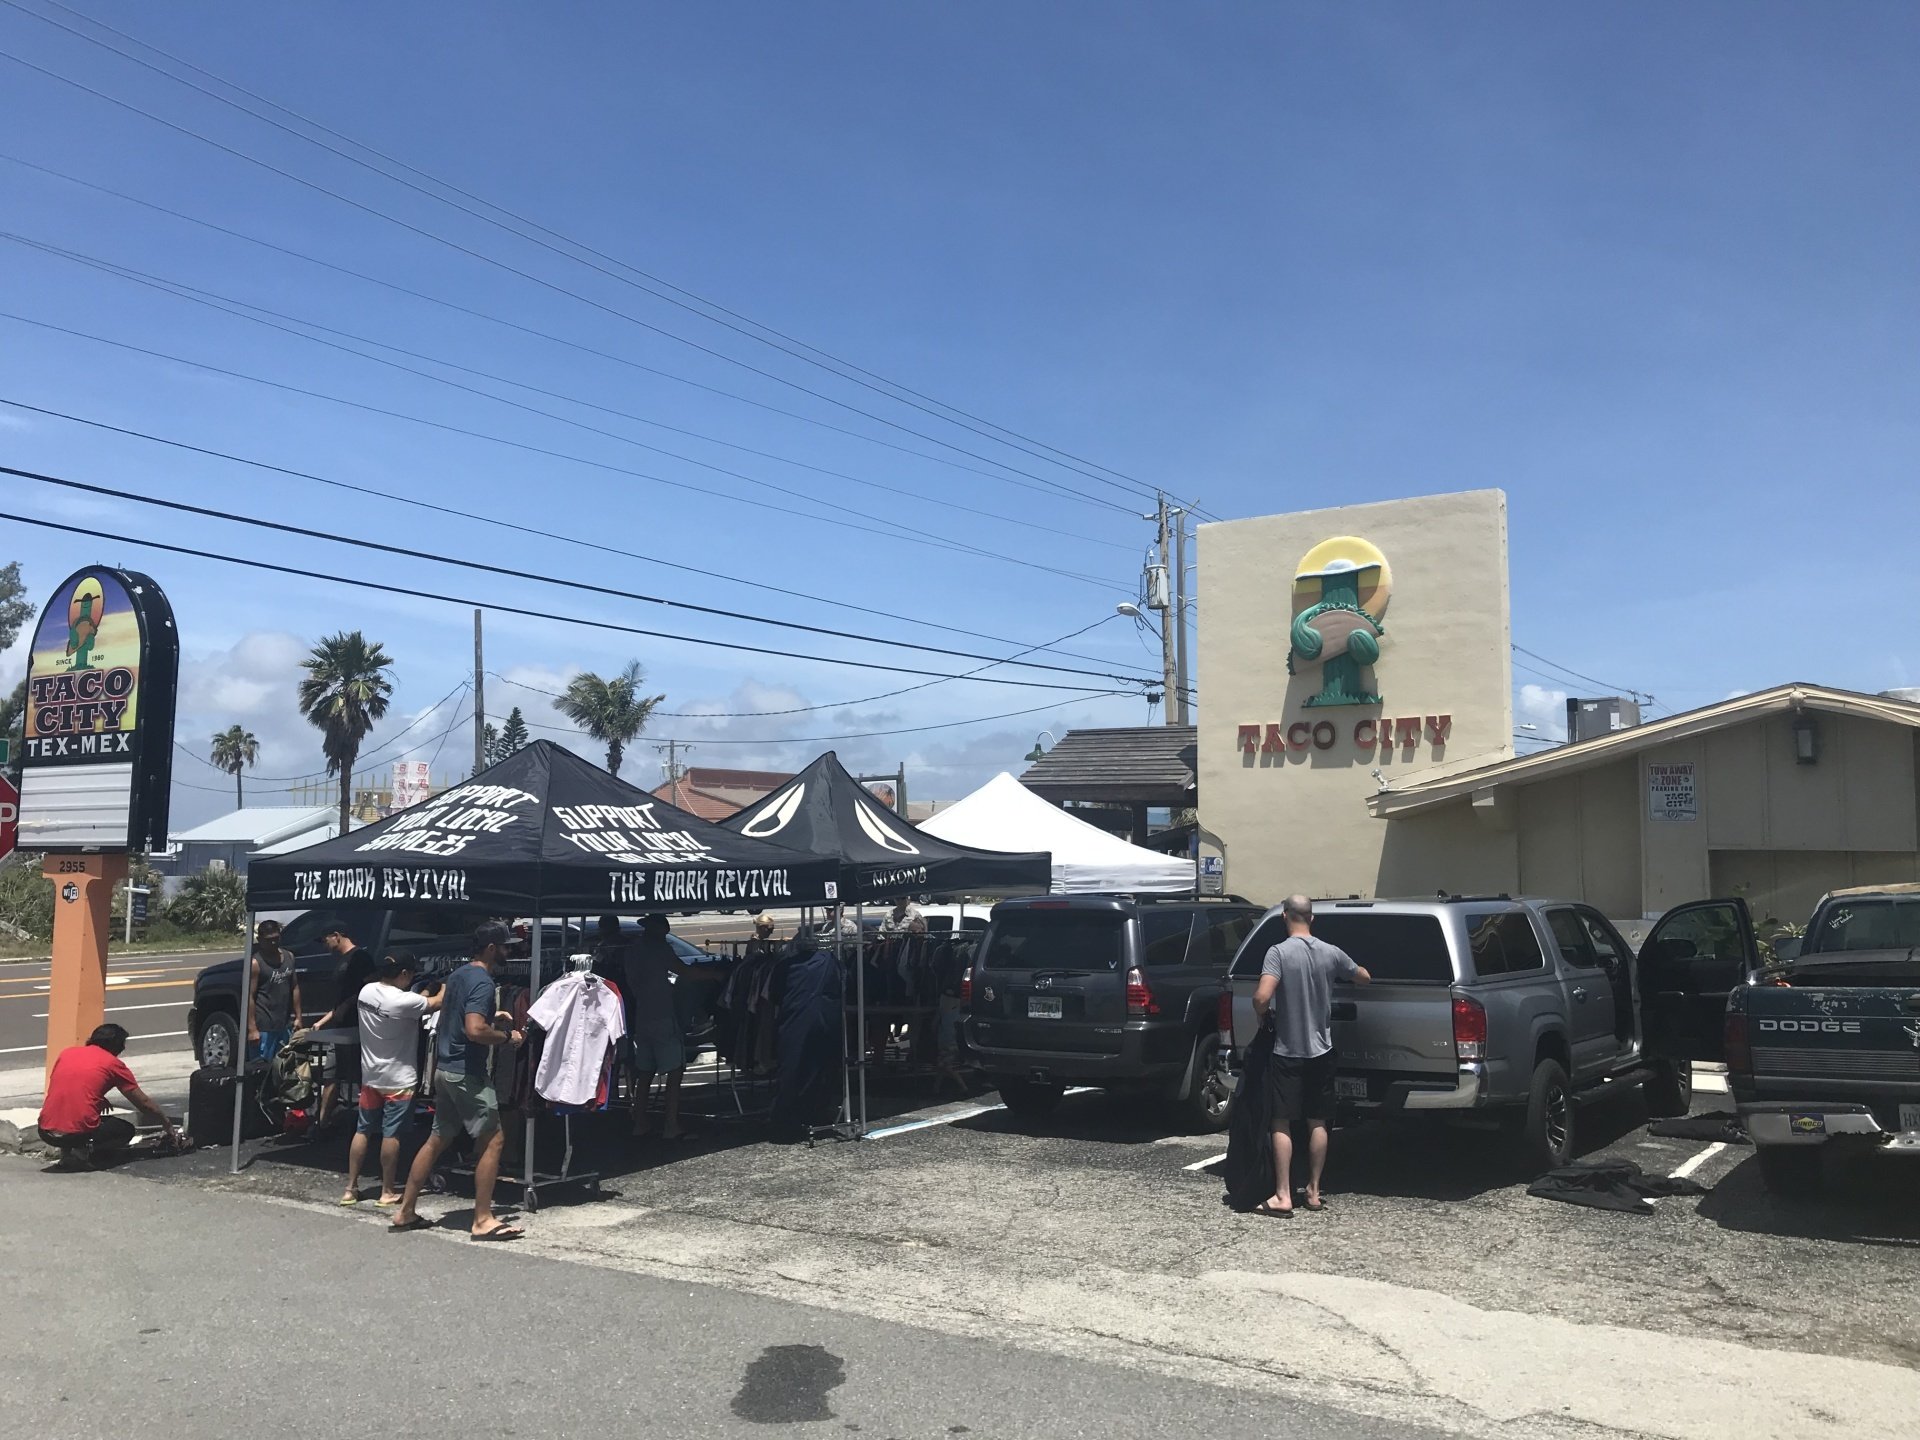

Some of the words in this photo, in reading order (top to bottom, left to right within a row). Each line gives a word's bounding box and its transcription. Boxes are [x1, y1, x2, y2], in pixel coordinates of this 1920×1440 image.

[56, 658, 72, 666] SINCE
[31, 668, 134, 704] TACO
[35, 700, 127, 733] CITY
[27, 733, 131, 757] TEX-MEX
[1238, 720, 1336, 753] TACO
[1354, 714, 1452, 750] CITY
[1650, 766, 1668, 775] TOW
[1669, 765, 1693, 775] AWAY
[1661, 776, 1681, 785] ZONE
[425, 785, 540, 809] SUPPORT
[383, 806, 449, 833] YOUR
[435, 806, 519, 833] LOCAL
[552, 802, 662, 830] SUPPORT
[354, 829, 477, 856] SAVAGES
[559, 831, 642, 852] YOUR
[630, 830, 712, 851] LOCAL
[60, 861, 86, 873] 2955
[872, 868, 917, 888] NIXON
[294, 870, 322, 900] THE
[327, 868, 376, 900] ROARK
[382, 868, 470, 901] REVIVAL
[609, 871, 646, 902] THE
[653, 870, 708, 901] ROARK
[715, 869, 792, 899] REVIVAL
[1759, 1019, 1861, 1033] DODGE
[1792, 1120, 1824, 1128] SUNOCO
